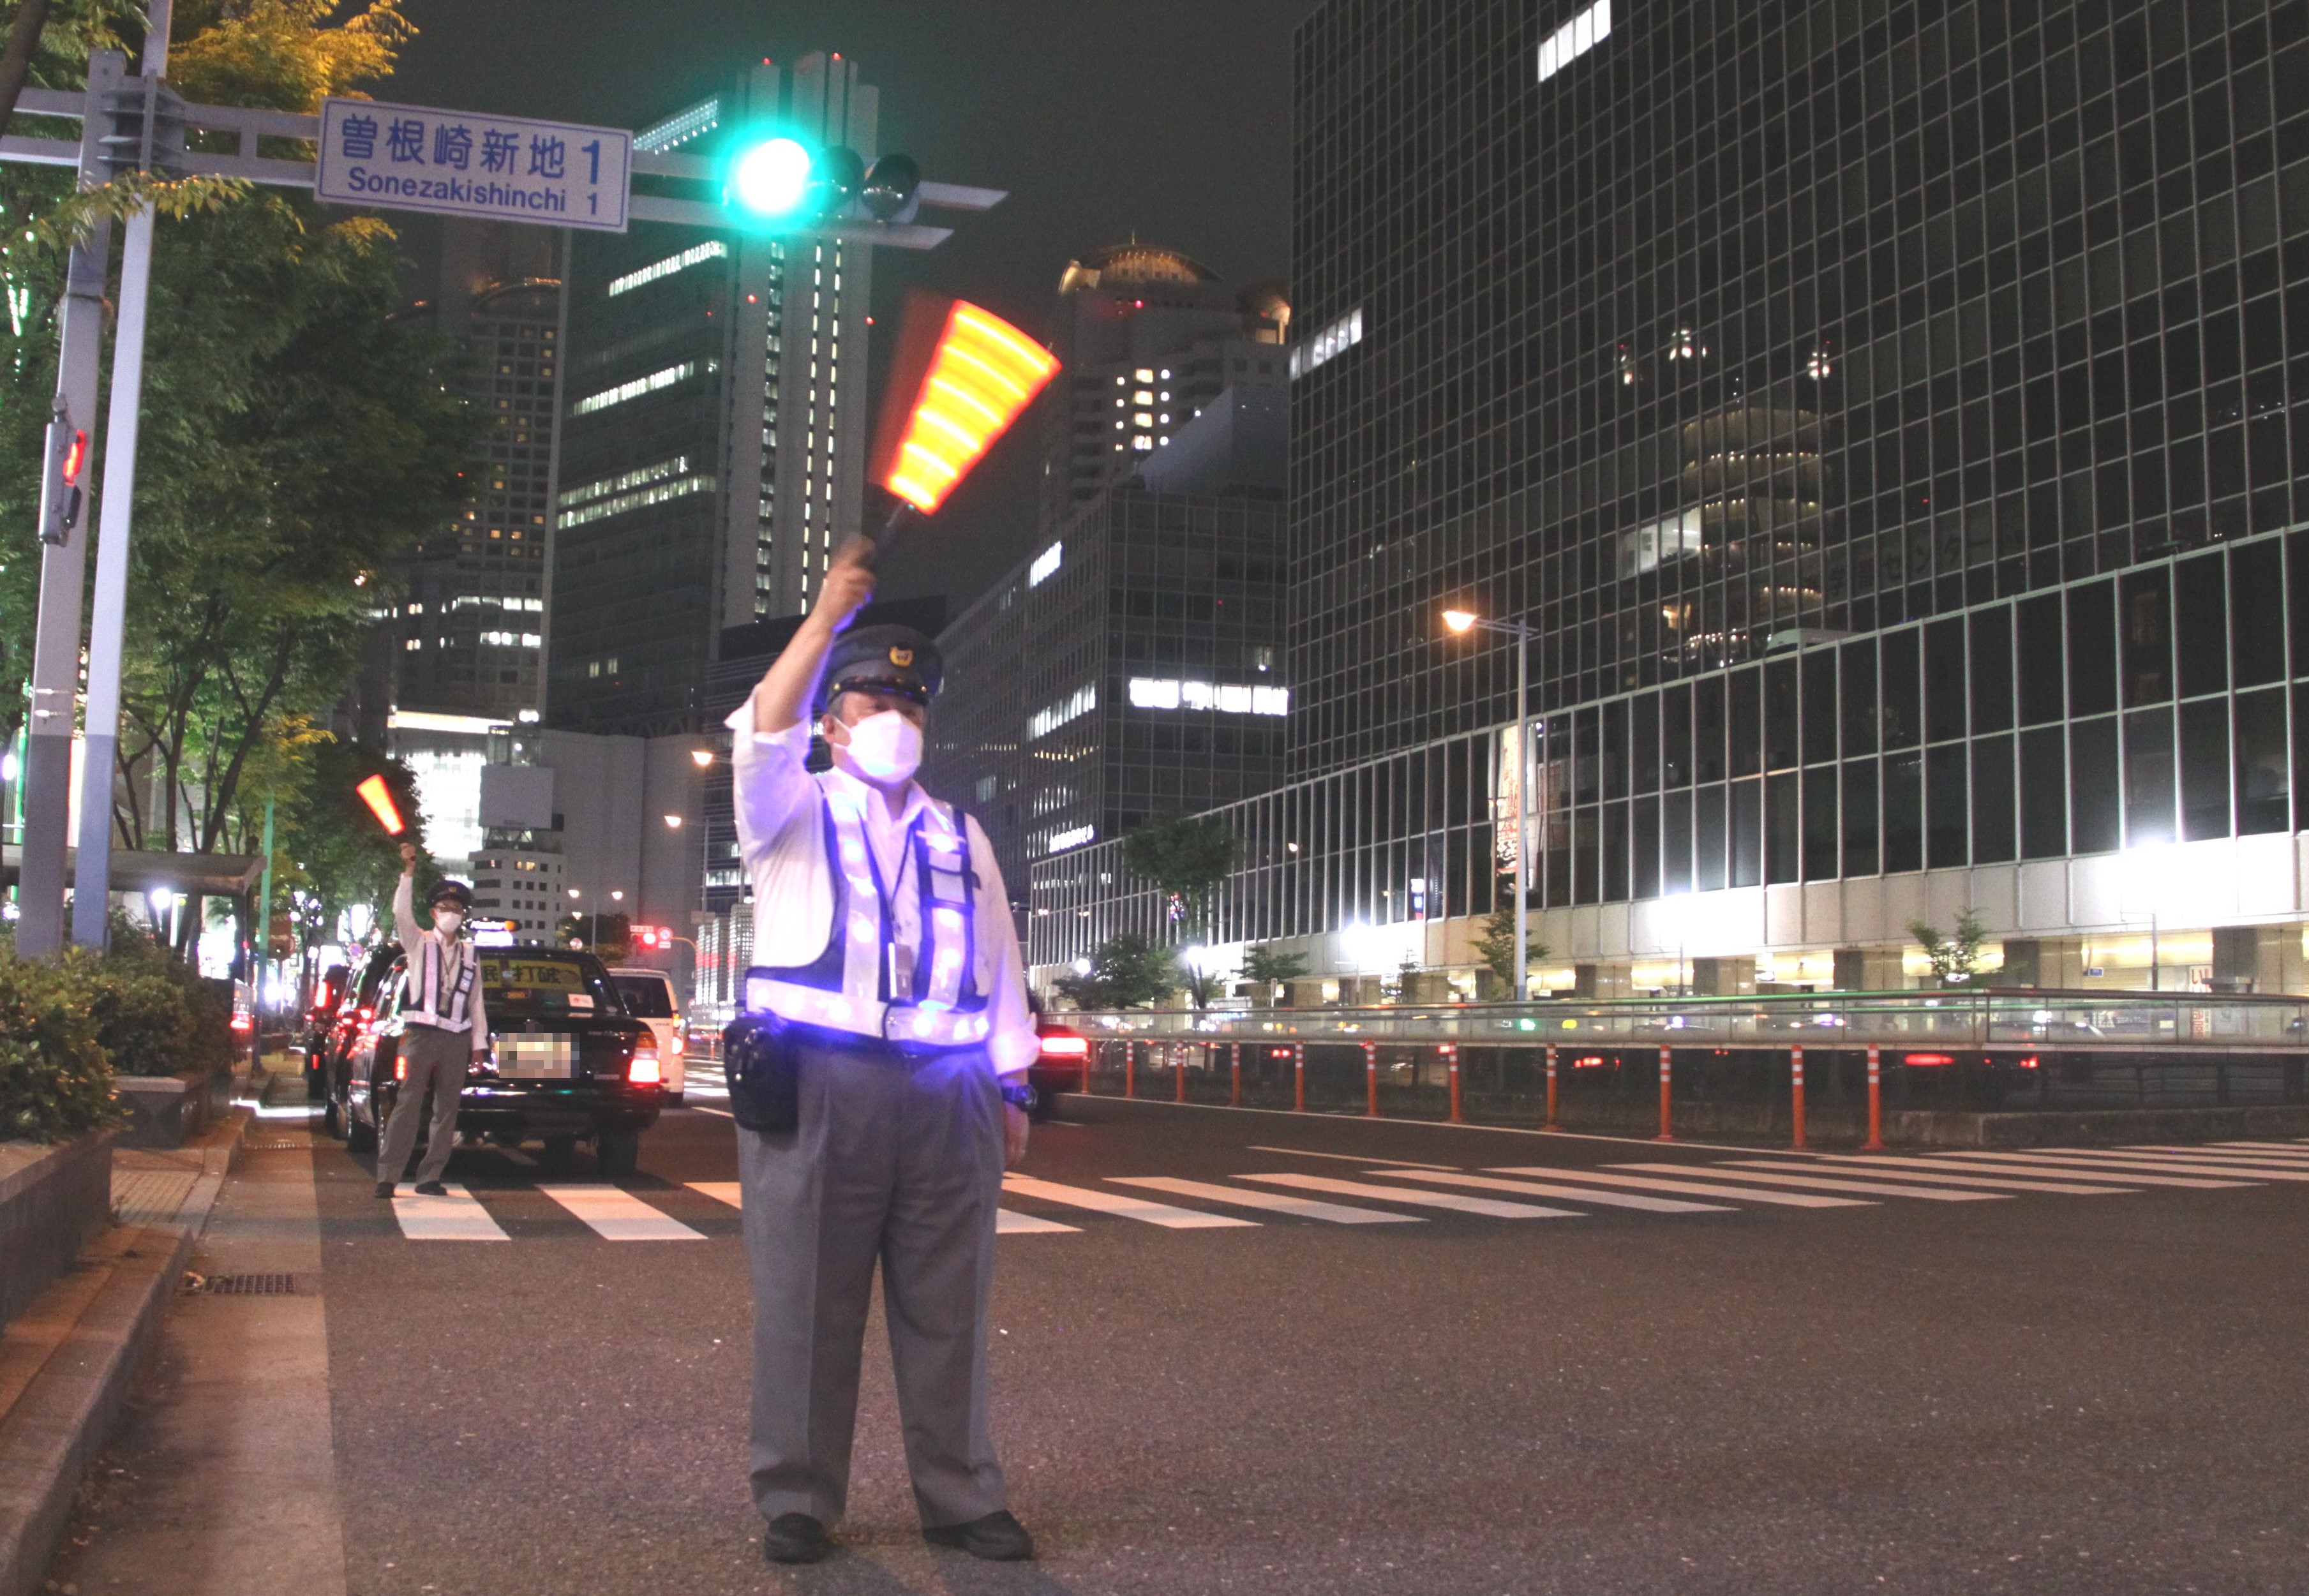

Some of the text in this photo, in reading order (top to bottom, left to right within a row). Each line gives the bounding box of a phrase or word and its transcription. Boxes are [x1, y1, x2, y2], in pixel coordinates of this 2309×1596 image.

[341, 113, 601, 185] 曽根崎新地 1
[348, 166, 597, 215] Sonezakishinchi 1
